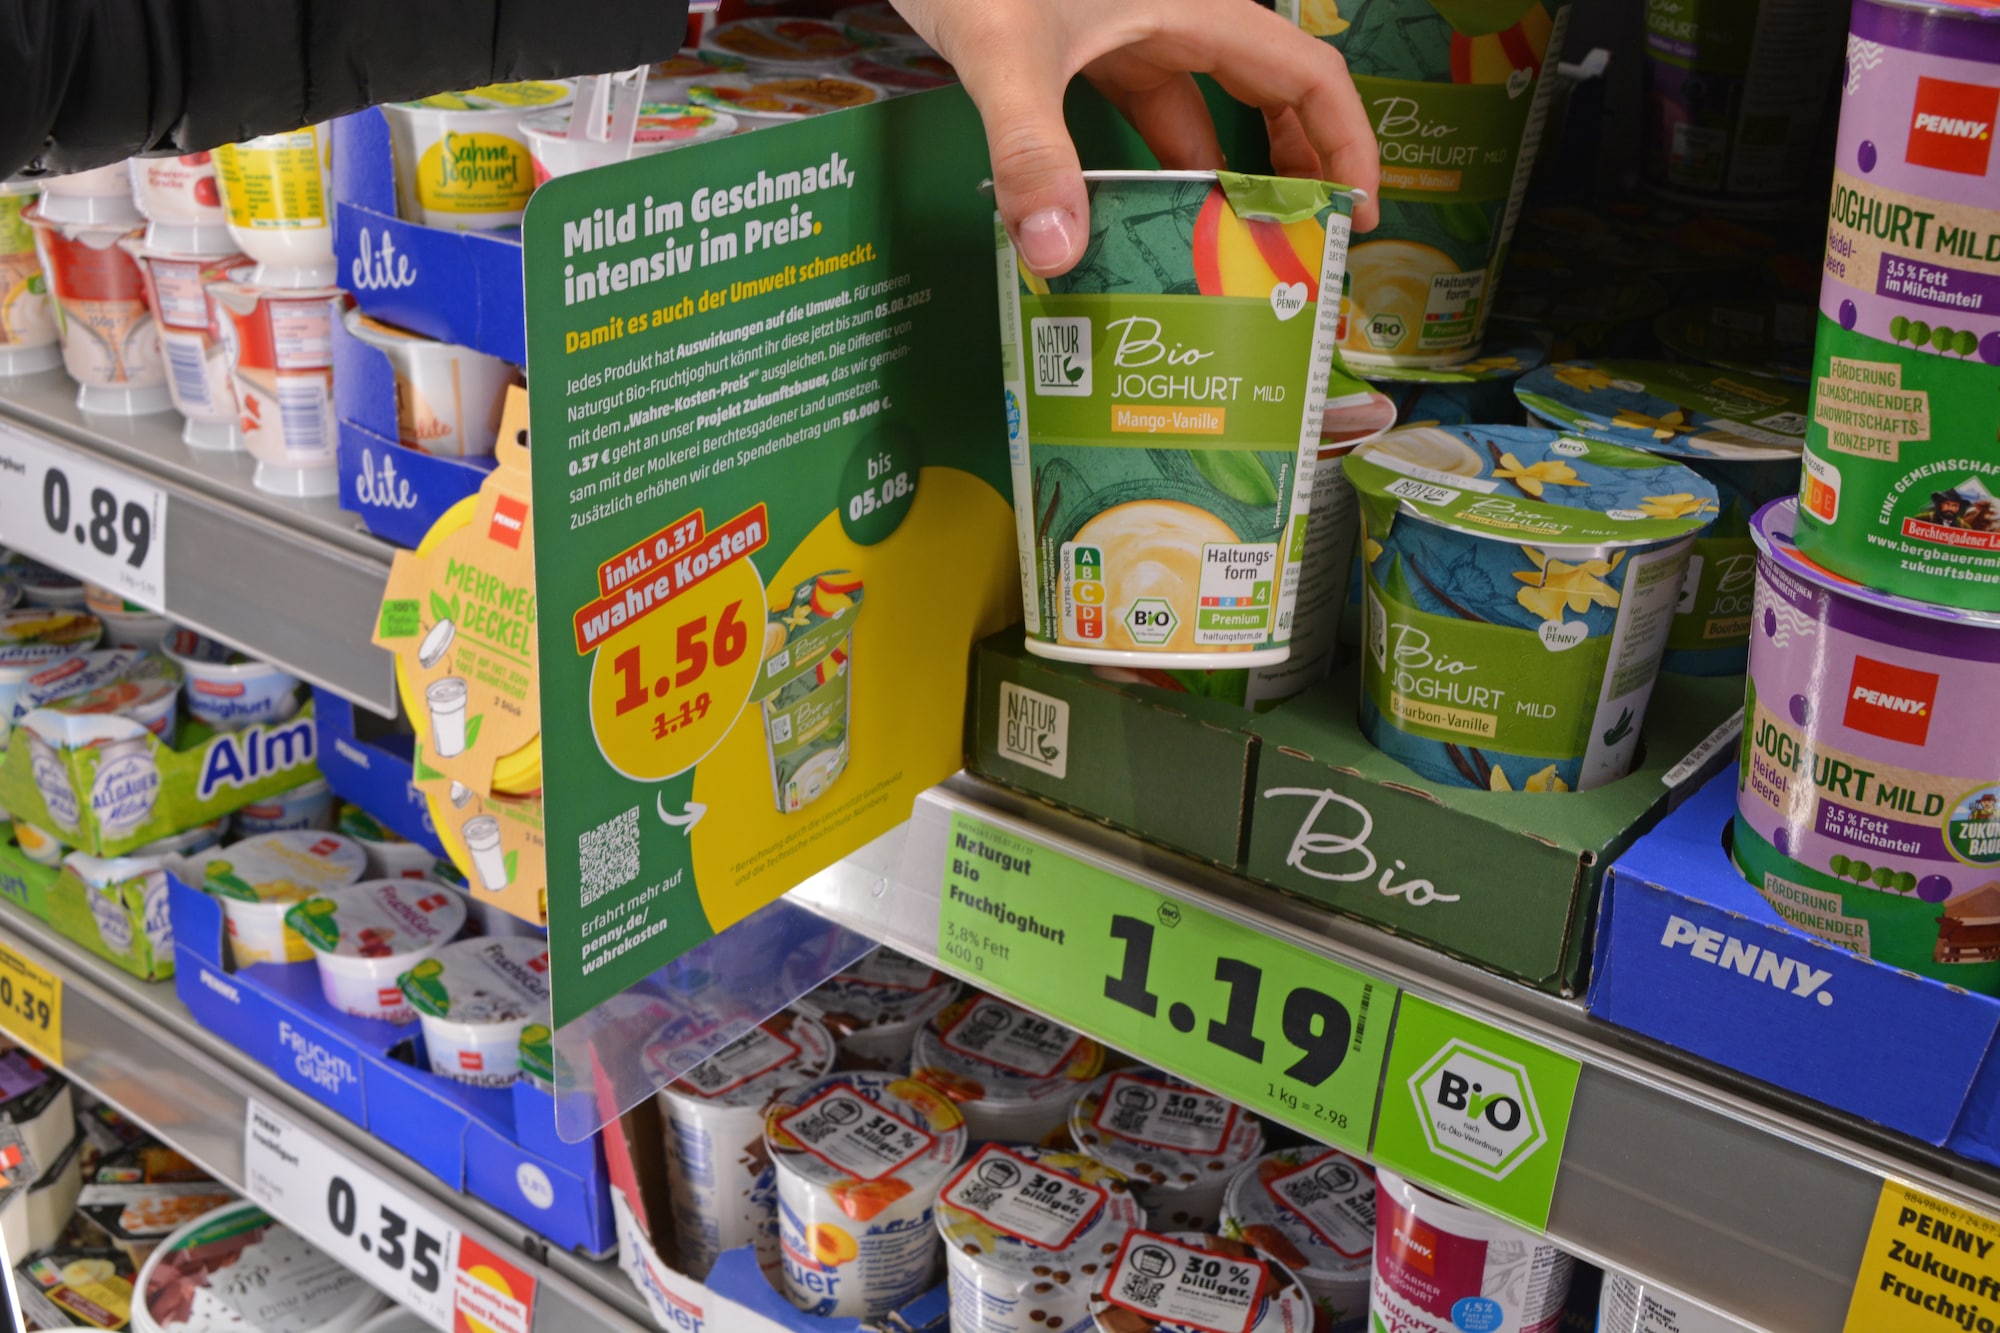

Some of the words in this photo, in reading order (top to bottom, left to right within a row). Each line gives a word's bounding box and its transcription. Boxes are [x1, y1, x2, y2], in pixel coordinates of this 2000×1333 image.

[1373, 96, 1459, 138] Bio
[443, 130, 510, 164] Sahne
[436, 154, 518, 190] Joghurt
[564, 203, 636, 258] Mild
[644, 195, 684, 236] im
[691, 152, 855, 223] Geschmack,
[1831, 184, 1934, 250] JOGHURT
[1935, 225, 2000, 262] MILD
[352, 227, 418, 290] elite
[565, 236, 694, 306] intensiv
[700, 227, 737, 267] im
[745, 203, 822, 254] Preis.
[1887, 260, 1906, 278] 3,5
[1906, 264, 1917, 281] %
[1918, 266, 1948, 288] Fett
[566, 316, 624, 354] Damit
[628, 312, 648, 334] es
[652, 296, 694, 327] auch
[698, 289, 728, 312] der
[731, 265, 796, 303] Umwelt
[799, 242, 876, 282] schmeckt.
[1276, 299, 1301, 310] PENNY
[1278, 289, 1287, 298] BY
[1885, 276, 1900, 292] im
[1902, 279, 1982, 310] Milchanteil
[567, 372, 602, 396] Jedes
[604, 354, 653, 383] Produkt
[655, 346, 675, 366] hat
[676, 320, 764, 360] Auswirkungen
[766, 310, 786, 331] auf
[786, 304, 804, 324] die
[806, 290, 852, 318] Umwelt.
[854, 285, 871, 302] Für
[1036, 325, 1079, 354] NATUR
[1105, 316, 1214, 368] Bio
[568, 390, 624, 422] Naturgut
[626, 356, 729, 403] Bio-Fruchtjoghurt
[731, 344, 764, 368] könnt
[765, 339, 780, 356] ihr
[782, 330, 810, 351] diese
[810, 320, 835, 344] jetzt
[836, 318, 850, 333] bis
[852, 310, 874, 327] zum
[1038, 354, 1062, 384] GUT
[1831, 360, 1896, 388] FÖRDERUNG
[568, 428, 590, 450] mit
[592, 420, 621, 442] dem
[760, 350, 828, 382] ausgleichen.
[829, 340, 846, 359] Die
[848, 327, 892, 352] Differenz
[1111, 374, 1243, 400] JOGHURT
[1253, 384, 1286, 402] MILD
[1818, 380, 1924, 414] KLIMASCHONENDER
[569, 452, 598, 476] 0.37
[612, 437, 641, 465] geht
[643, 432, 659, 450] an
[661, 420, 694, 443] unser
[696, 400, 742, 430] Projekt
[743, 373, 830, 415] Zukunftsbauer,
[831, 366, 849, 382] das
[850, 357, 867, 376] wir
[1118, 410, 1219, 433] Mango-Vanille
[1816, 402, 1928, 436] LANDWIRTSCHAFTS-
[570, 484, 596, 504] sam
[600, 472, 621, 492] mit
[624, 464, 646, 484] der
[648, 440, 700, 475] Molkerei
[702, 408, 798, 454] Berchtesgadener
[800, 395, 826, 418] Land
[828, 379, 880, 408] umsetzen.
[1833, 431, 1892, 456] KONZEPTE
[356, 448, 418, 510] elite
[570, 492, 633, 530] Zusätzlich
[636, 475, 688, 504] erhöhen
[690, 464, 710, 484] wir
[712, 455, 734, 476] den
[736, 424, 822, 466] Spendenbetrag
[823, 416, 841, 433] um
[842, 400, 880, 426] 50.000
[868, 452, 892, 480] bis
[848, 472, 914, 520] 05.08.
[1400, 481, 1450, 498] NATUR
[43, 467, 150, 570] 0.89
[1462, 508, 1572, 532] JOGHURT
[1472, 496, 1554, 520] Bio
[1879, 492, 1899, 526] EINE
[1908, 521, 1988, 548] Berchtesgadener
[605, 548, 653, 590] inkl.
[655, 519, 697, 560] 0.37
[1082, 550, 1094, 564] A
[1208, 549, 1274, 566] Haltungs-
[582, 575, 670, 644] wahre
[674, 521, 762, 590] Kosten
[1064, 550, 1072, 616] NUTRI-SCORE
[1082, 566, 1092, 579] B
[1224, 565, 1258, 580] form
[1081, 586, 1094, 602] C
[1256, 586, 1266, 604] 4
[462, 600, 532, 656] DECKEL
[1082, 606, 1094, 620] D
[1084, 622, 1094, 636] E
[1211, 612, 1260, 626] Premium
[1547, 625, 1559, 633] BY
[1202, 631, 1263, 642] haltungsform.de
[1390, 623, 1478, 674] Bio
[1545, 632, 1578, 644] PENNY
[614, 599, 748, 717] 1.56
[1392, 667, 1506, 710] JOGHURT
[1516, 700, 1556, 720] MILD
[1006, 692, 1058, 734] NATUR
[1393, 697, 1490, 733] Bourbon-Vanille
[1006, 720, 1037, 752] GUT
[201, 720, 314, 797] Alm
[1754, 717, 1876, 802] JOGHURT
[1876, 781, 1945, 818] MILD
[1754, 752, 1792, 793] Heidel-
[1751, 772, 1780, 808] beere
[1824, 818, 1838, 834] im
[1841, 822, 1921, 854] Milchanteil
[1826, 806, 1845, 823] 3,5
[1846, 810, 1857, 824] %
[1860, 812, 1889, 835] Fett
[1263, 788, 1461, 906] Bio
[952, 858, 980, 882] Bio
[582, 902, 625, 938] Erfahrt
[627, 883, 660, 912] mehr
[662, 868, 682, 892] auf
[1766, 878, 1837, 914] FÖRDERUNG
[949, 884, 1066, 946] Fruchtjoghurt
[582, 906, 649, 961] penny.de/
[582, 918, 668, 976] wahrekosten
[983, 936, 1010, 960] Fett
[945, 942, 972, 964] 400
[975, 956, 984, 972] g
[0, 976, 50, 1031] 0.39
[1103, 914, 1352, 1088] 1.19
[278, 1020, 357, 1084] FRUCHT-
[294, 1053, 339, 1095] GURT
[1162, 1107, 1222, 1126] billiger.
[1168, 1094, 1198, 1110] 30
[1205, 1100, 1226, 1114] %
[1266, 1082, 1276, 1098] 1
[1278, 1086, 1298, 1113] kg
[1314, 1102, 1348, 1130] 2.98
[853, 1125, 904, 1158] billiger.
[865, 1115, 898, 1138] 30
[897, 1132, 919, 1150] %
[1436, 1121, 1504, 1157] EG-Öko-Verordnung
[1463, 1122, 1480, 1134] nach
[1020, 1186, 1080, 1218] billiger.
[1028, 1174, 1063, 1194] 30
[1068, 1188, 1088, 1206] %
[328, 1176, 442, 1294] 0.35
[1898, 1206, 1995, 1260] PENNY
[1180, 1272, 1250, 1300] billiger.
[1184, 1254, 1222, 1278] 30
[1230, 1264, 1250, 1286] %
[1384, 1256, 1441, 1297] FETTARMER
[1388, 1272, 1434, 1304] JOGHURT
